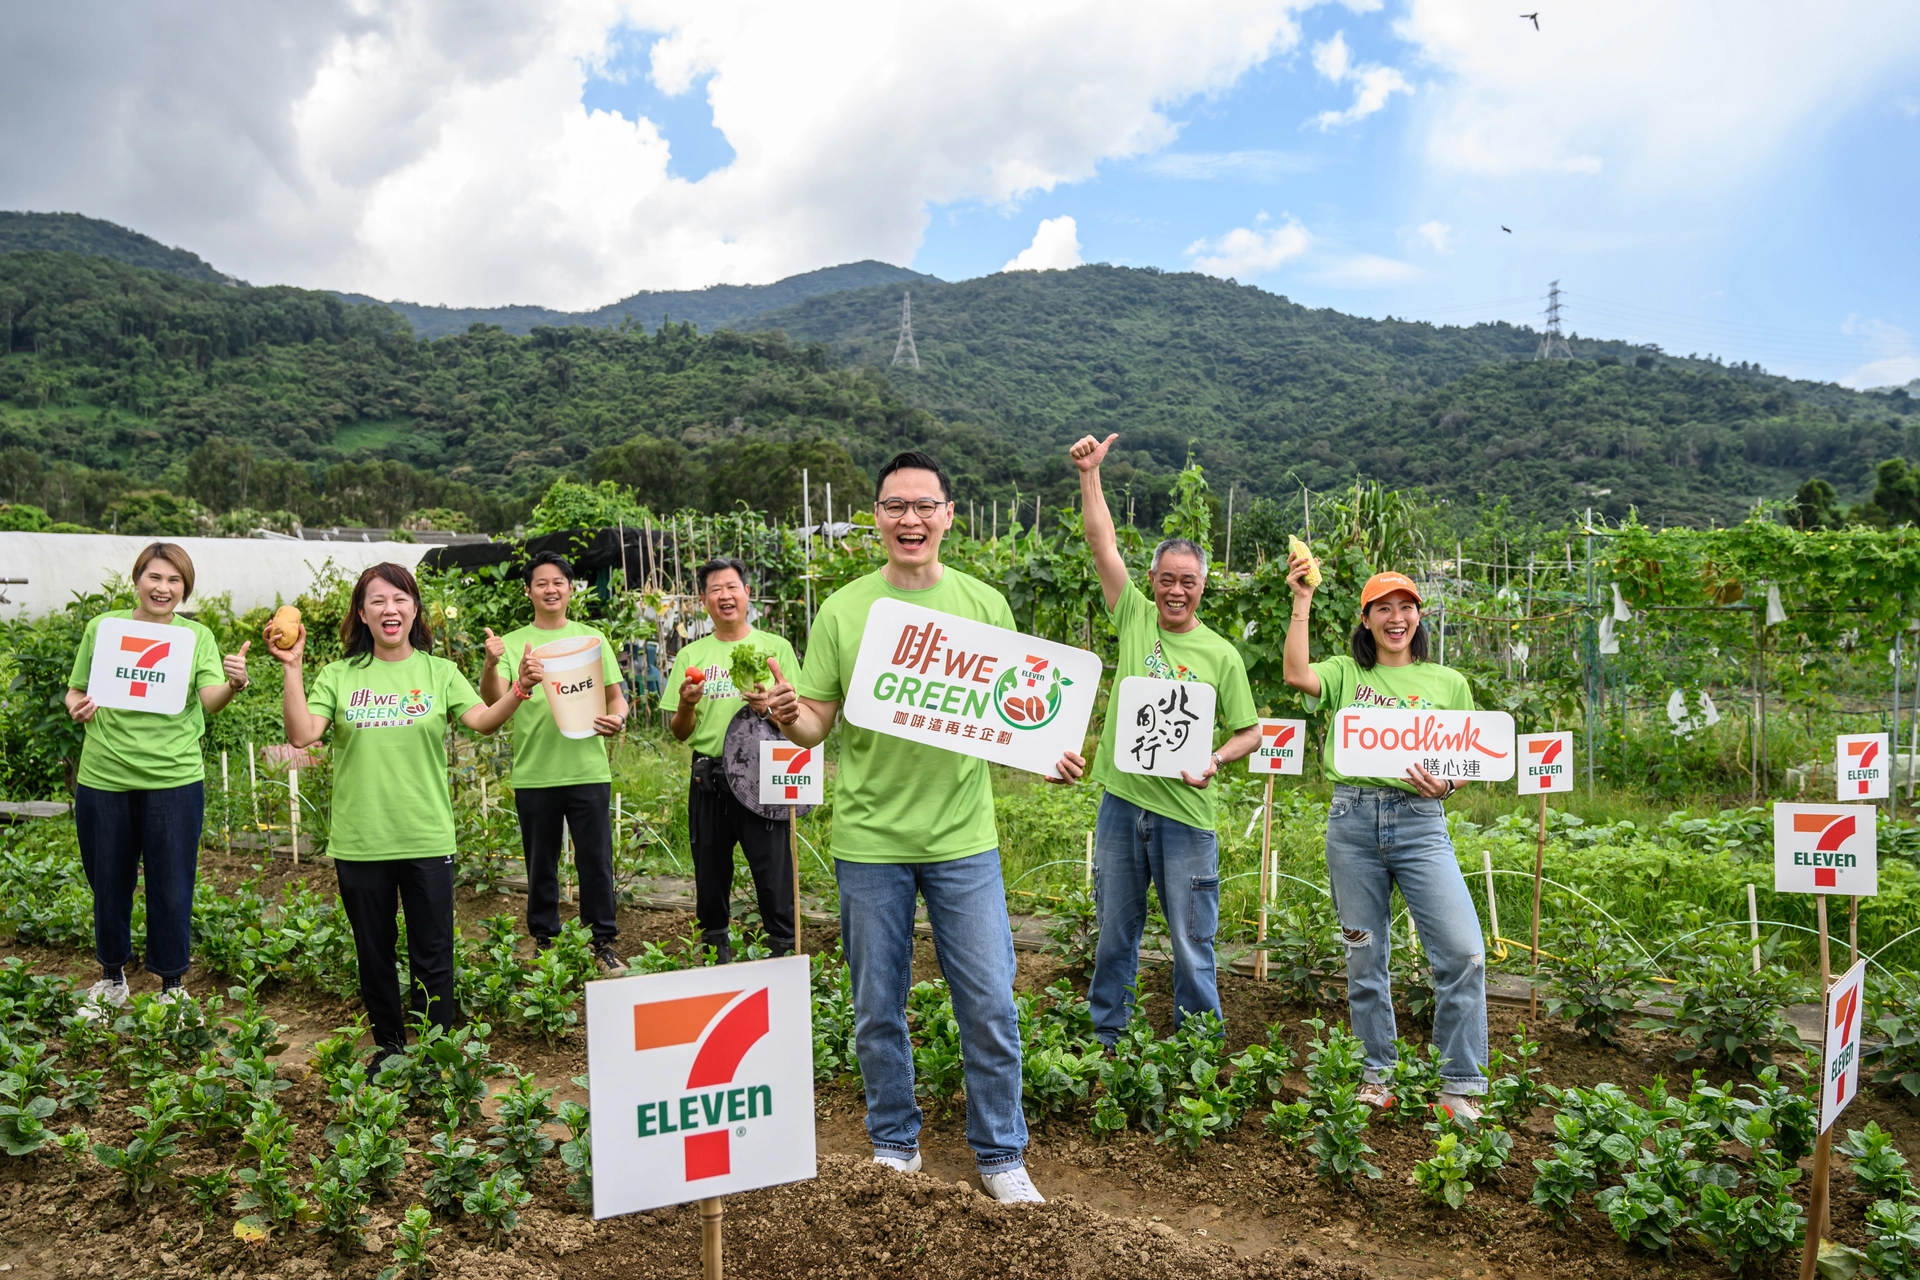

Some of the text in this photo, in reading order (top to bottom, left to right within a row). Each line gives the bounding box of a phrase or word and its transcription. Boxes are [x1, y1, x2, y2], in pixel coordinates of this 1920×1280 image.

[120, 635, 171, 698] 7
[1025, 654, 1049, 688] 7
[345, 707, 399, 721] GREEN
[873, 671, 991, 719] GREEN
[892, 710, 1013, 745] 咖啡渣再生企劃
[1262, 724, 1295, 769] 7
[1343, 714, 1508, 759] Foodlink
[772, 748, 811, 799] 7
[1423, 758, 1481, 777] 膳心連
[1528, 739, 1562, 788] 7
[1847, 741, 1878, 794] 7
[1793, 813, 1856, 887] 7
[1834, 981, 1858, 1106] 7
[634, 986, 770, 1182] 7
